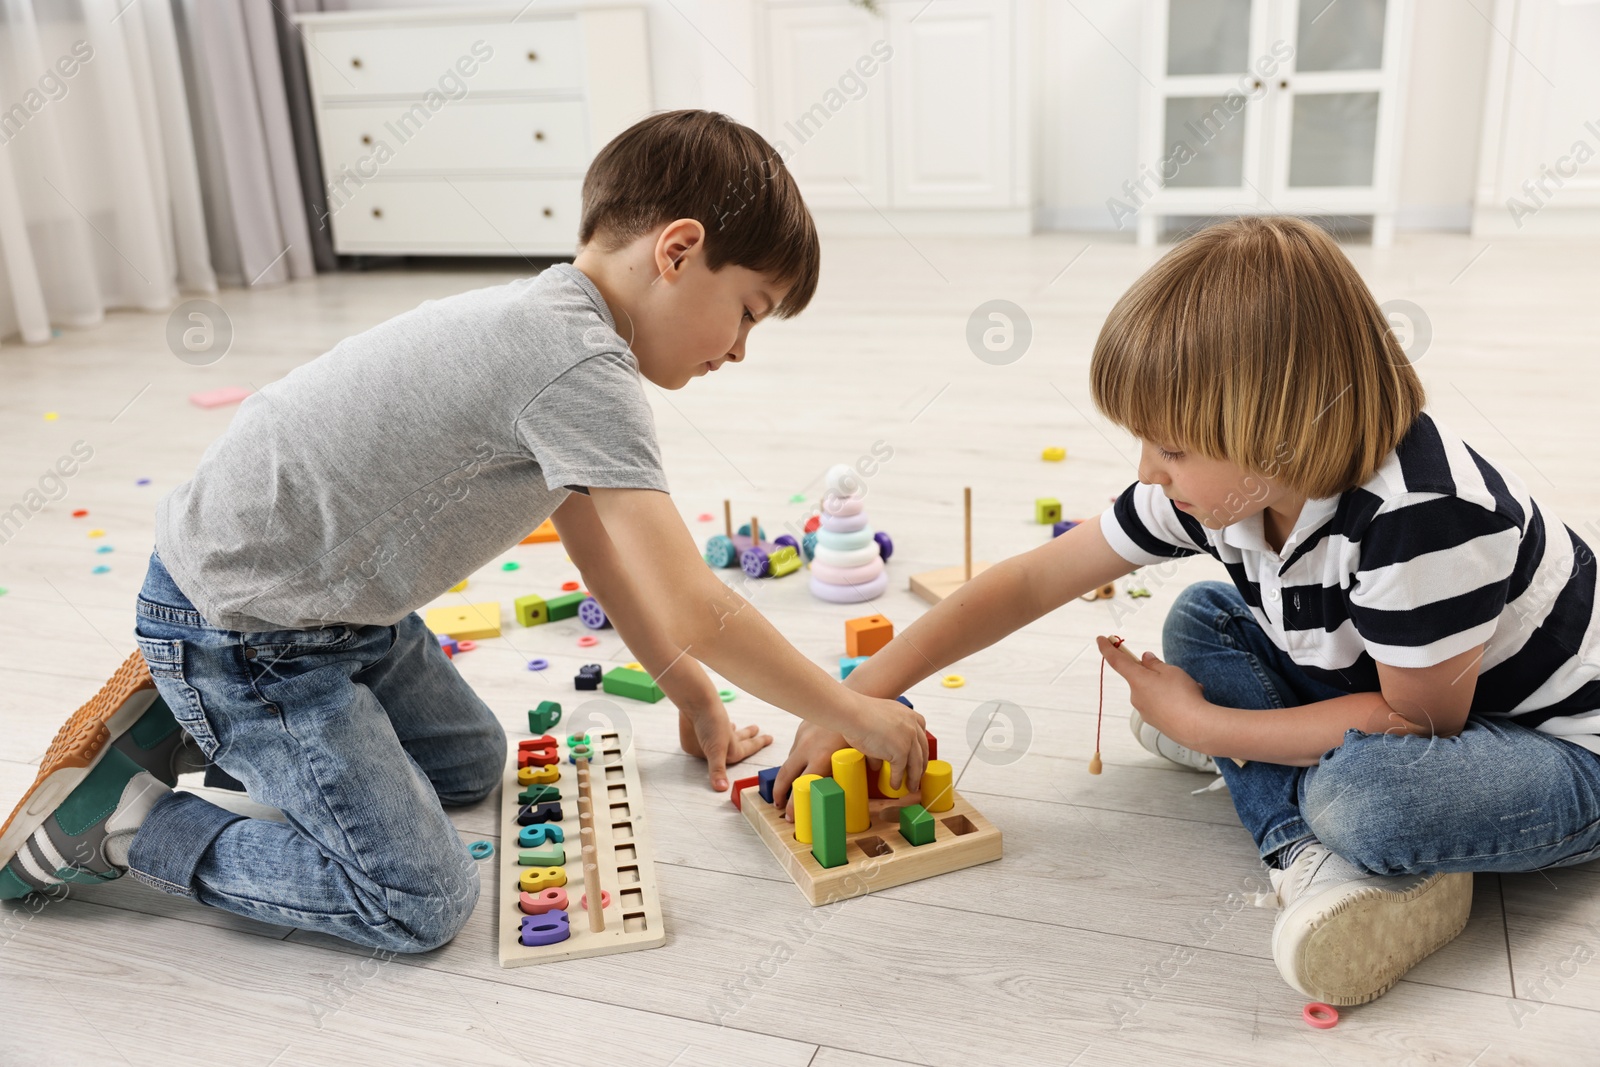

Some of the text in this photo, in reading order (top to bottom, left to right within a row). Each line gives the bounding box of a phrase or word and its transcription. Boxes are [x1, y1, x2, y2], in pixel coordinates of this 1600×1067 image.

[518, 735, 569, 946] 1 2 3 4 5 6 7 8 9 10
